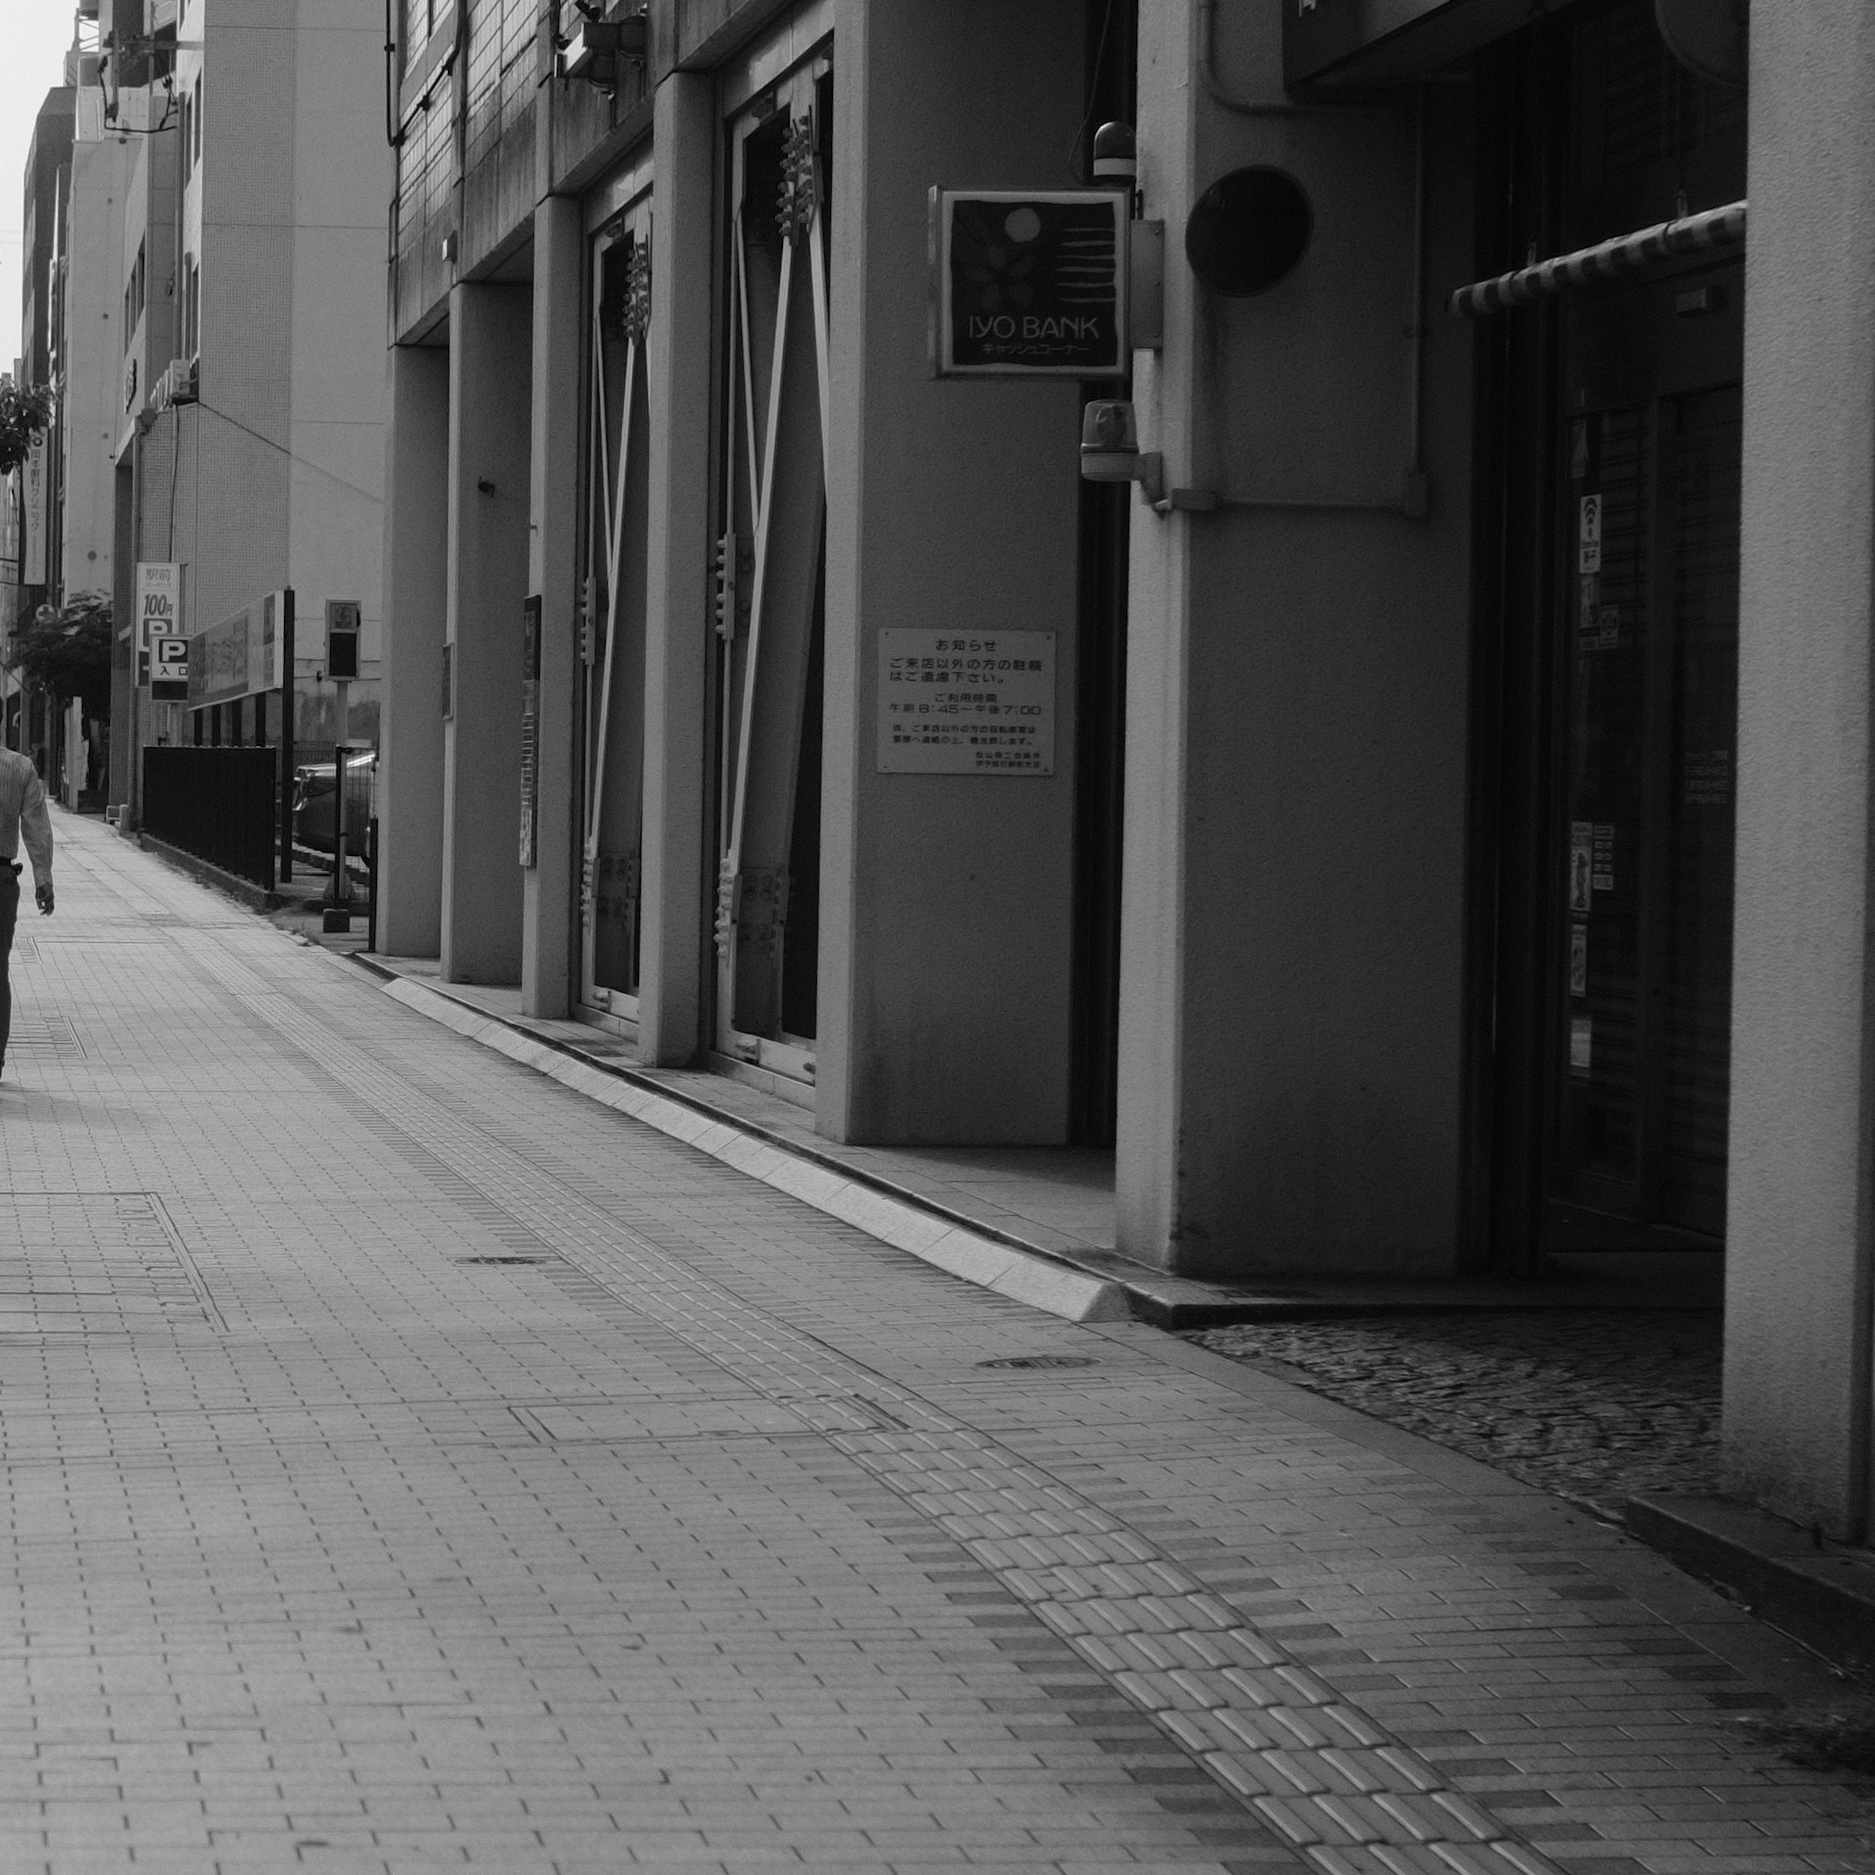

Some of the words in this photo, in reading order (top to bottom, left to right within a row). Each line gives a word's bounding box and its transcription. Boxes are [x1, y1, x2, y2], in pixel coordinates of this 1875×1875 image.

[969, 316, 1016, 339] IYO
[1023, 316, 1100, 340] BANK
[982, 343, 1091, 355] キャッシュコーナー
[146, 568, 171, 582] 駅前
[144, 594, 173, 617] 100円
[161, 641, 187, 662] P
[935, 639, 997, 652] お知らせ
[160, 666, 188, 676] 入口
[889, 657, 1042, 672] ご来店以外の方の駐輪
[889, 671, 1005, 684] はご遠慮下さい。
[934, 693, 998, 703] ご利用時間
